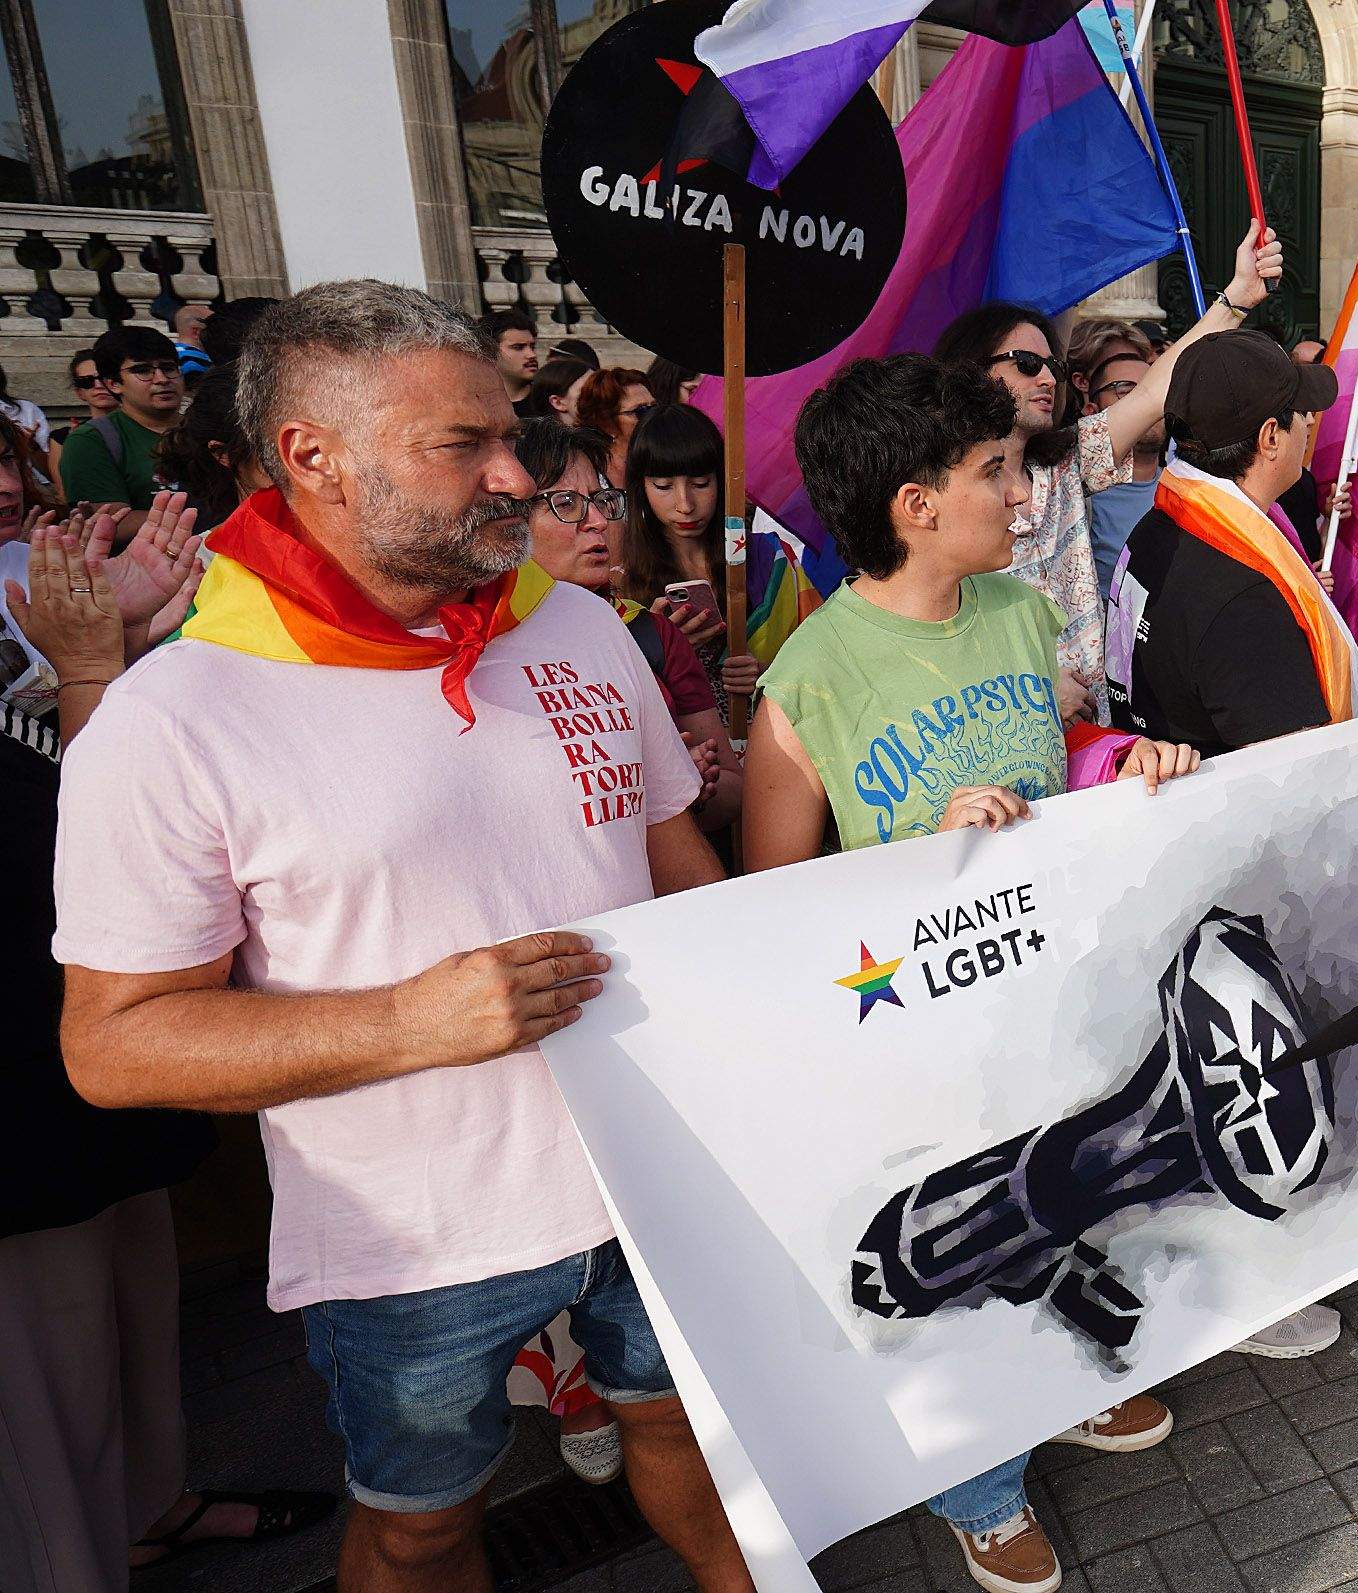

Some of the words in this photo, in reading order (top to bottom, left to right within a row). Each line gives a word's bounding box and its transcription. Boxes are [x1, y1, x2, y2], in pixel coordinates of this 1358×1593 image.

[580, 165, 732, 233] GALIZA
[758, 206, 865, 261] NOVA
[521, 661, 579, 688] LES
[534, 682, 625, 714] BIANA
[1108, 686, 1128, 703] TOP
[548, 707, 635, 740] BOLLE
[561, 739, 612, 768] RA
[854, 695, 966, 843] SOLAR
[572, 762, 645, 797] TORT
[913, 883, 1036, 951] AVANTE
[921, 929, 1046, 999] LGBT+
